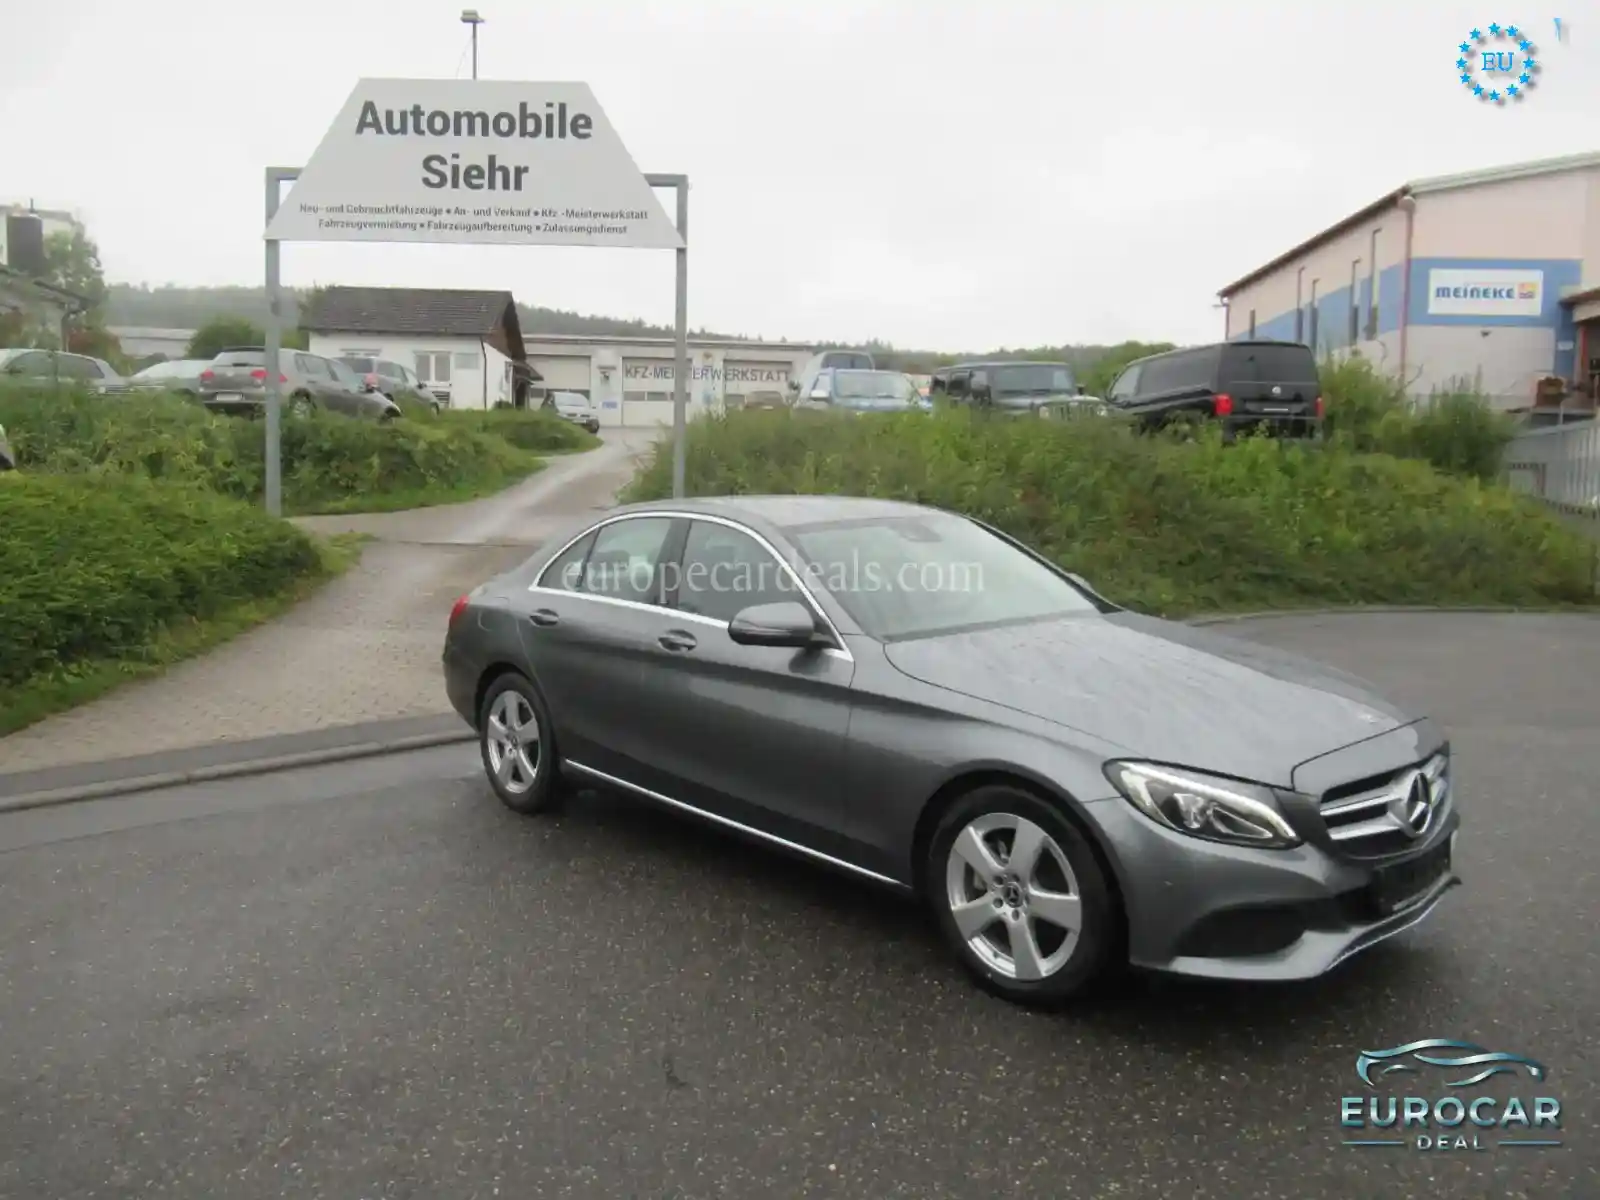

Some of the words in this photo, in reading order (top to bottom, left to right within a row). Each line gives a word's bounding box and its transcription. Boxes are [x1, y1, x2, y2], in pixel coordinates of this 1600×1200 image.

[355, 100, 593, 139] Automobile
[421, 153, 530, 192] Siehr
[325, 204, 344, 214] und
[346, 204, 443, 217] Gebrauchtfahrzeuge
[473, 208, 492, 217] und
[494, 207, 531, 218] Verkauf
[318, 218, 417, 231] Fahrzeugvermietung
[427, 220, 533, 234] Fahrzeugaufbereitung
[542, 223, 628, 235] Zulassungsdienst
[625, 364, 790, 382] KFZ-MEIERWERKSTATT
